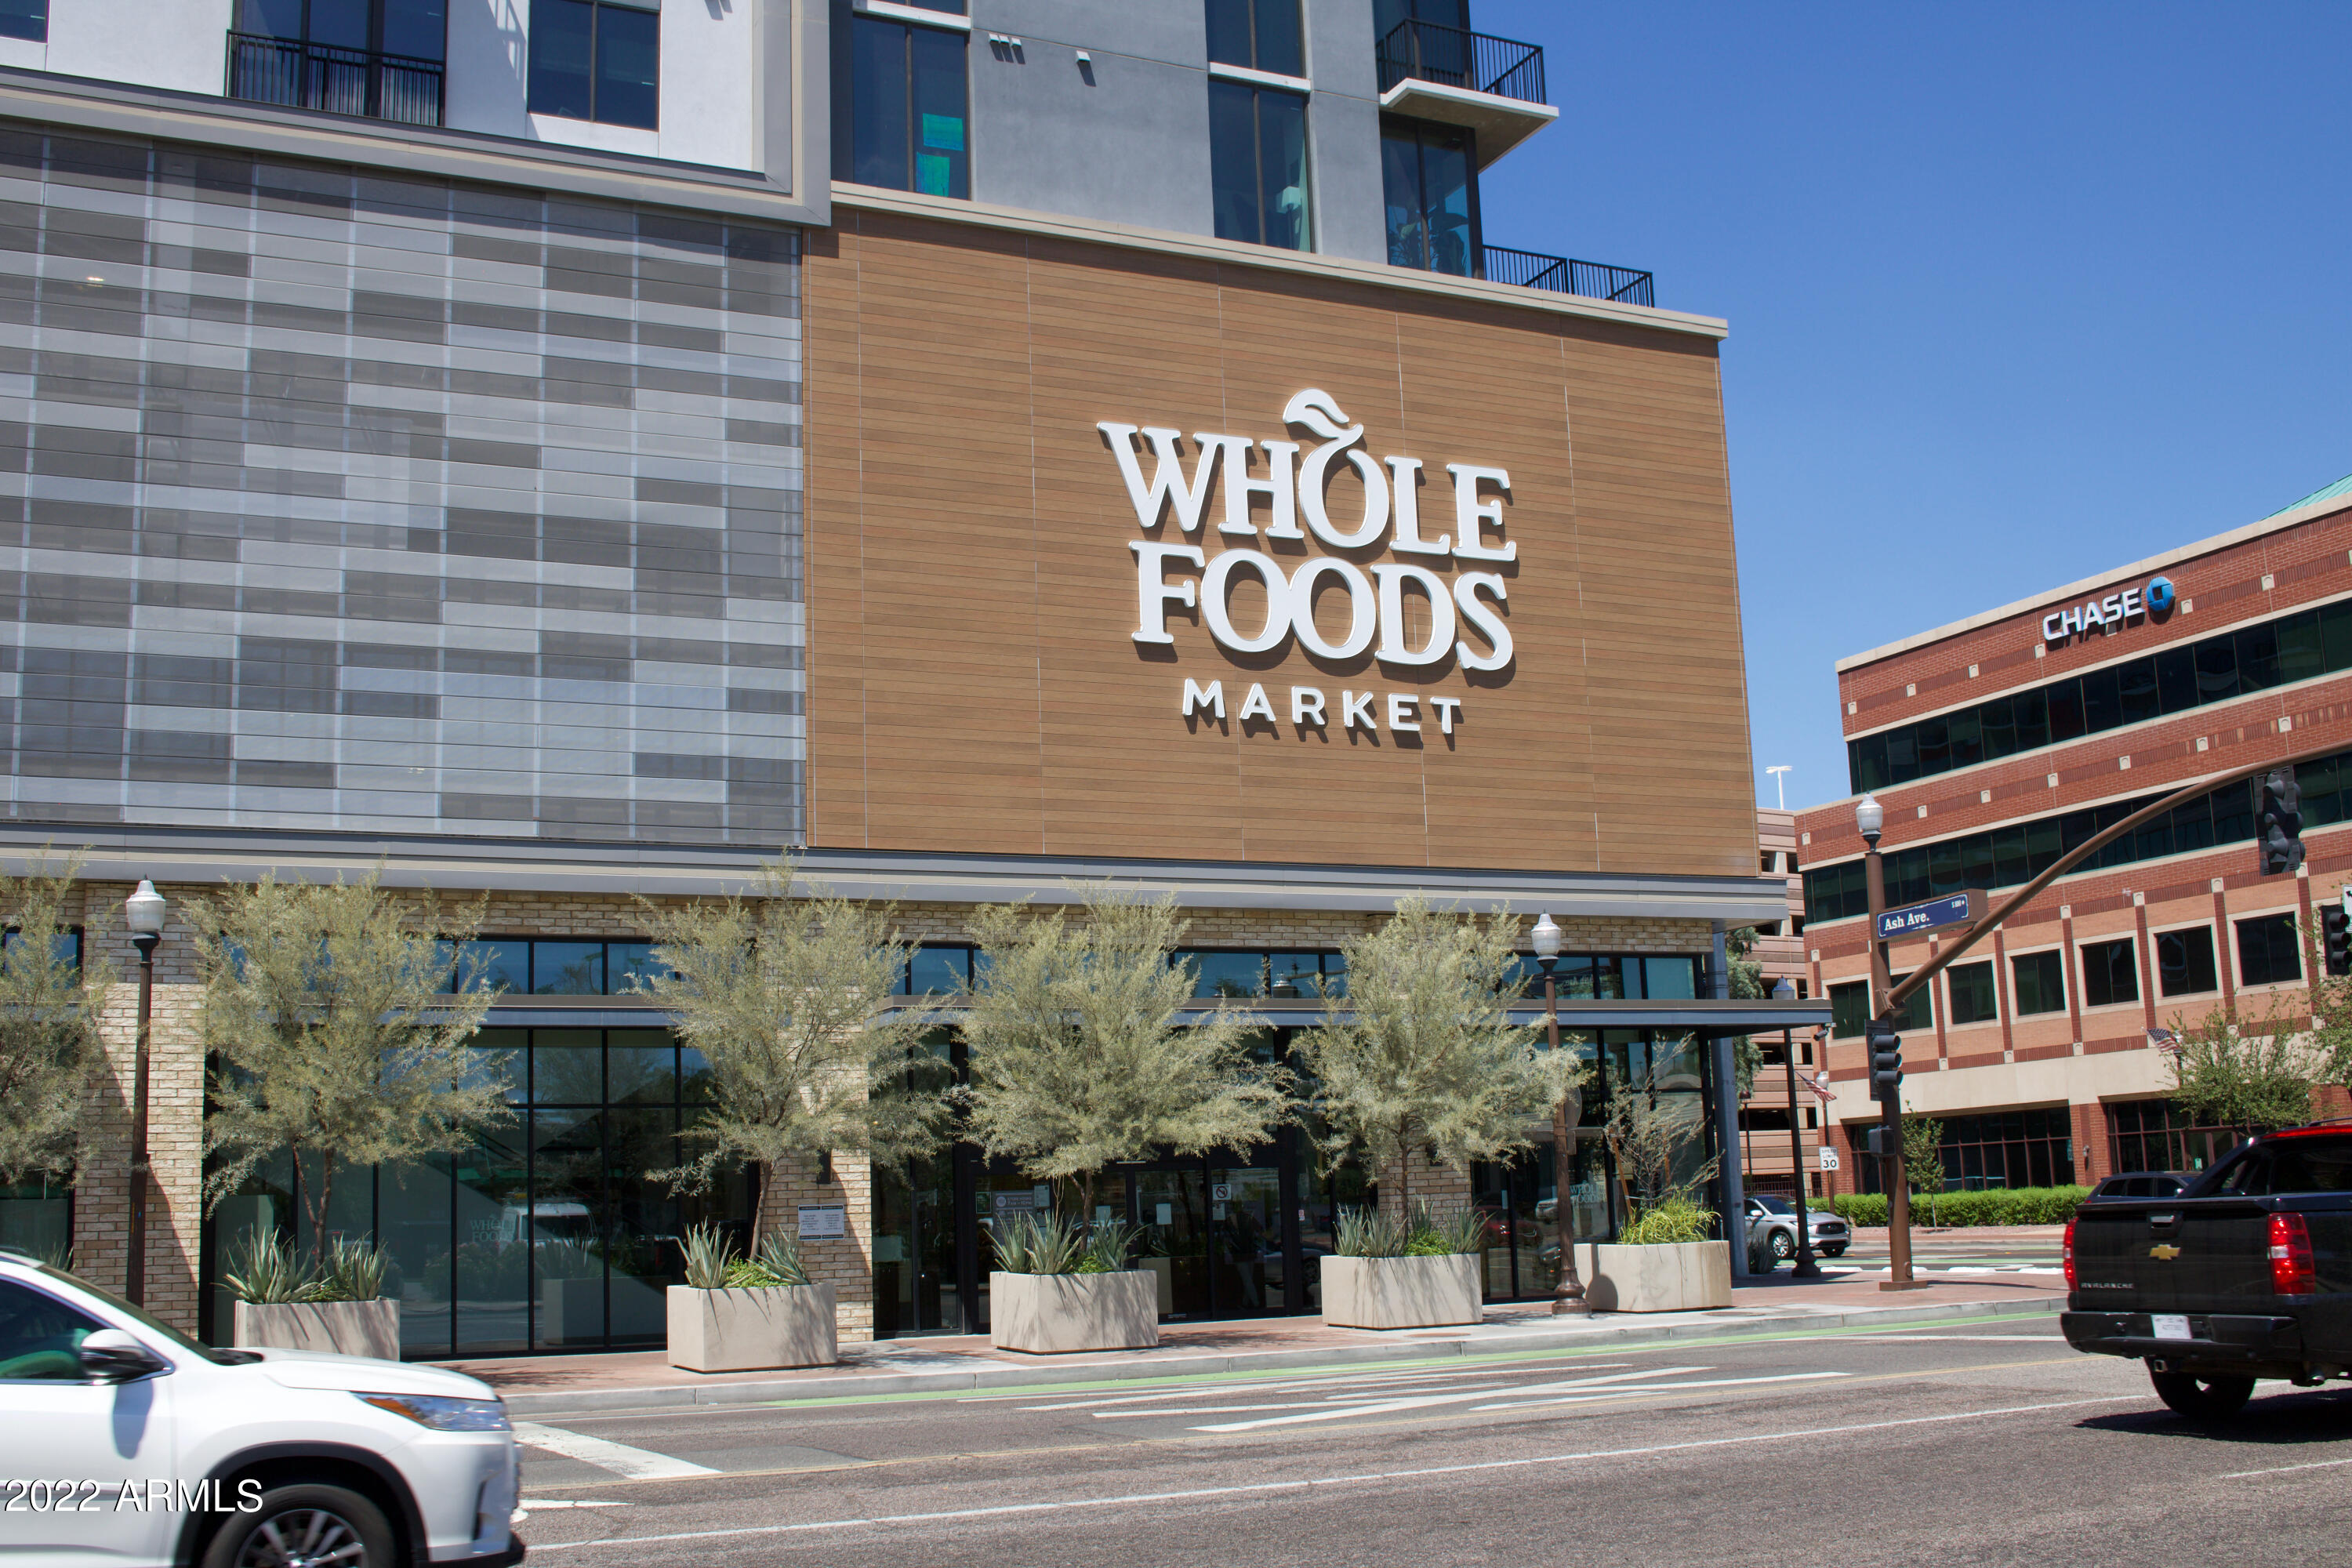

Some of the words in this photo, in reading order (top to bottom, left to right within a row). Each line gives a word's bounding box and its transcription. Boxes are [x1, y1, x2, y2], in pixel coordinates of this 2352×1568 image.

[1097, 388, 1517, 562] WHOLE
[1128, 539, 1513, 671] FOODS
[2042, 588, 2146, 641] CHASE
[1182, 678, 1461, 735] MARKET
[1884, 916, 1905, 931] Ash
[1907, 913, 1930, 926] Ave.
[1823, 1160, 1837, 1168] 30
